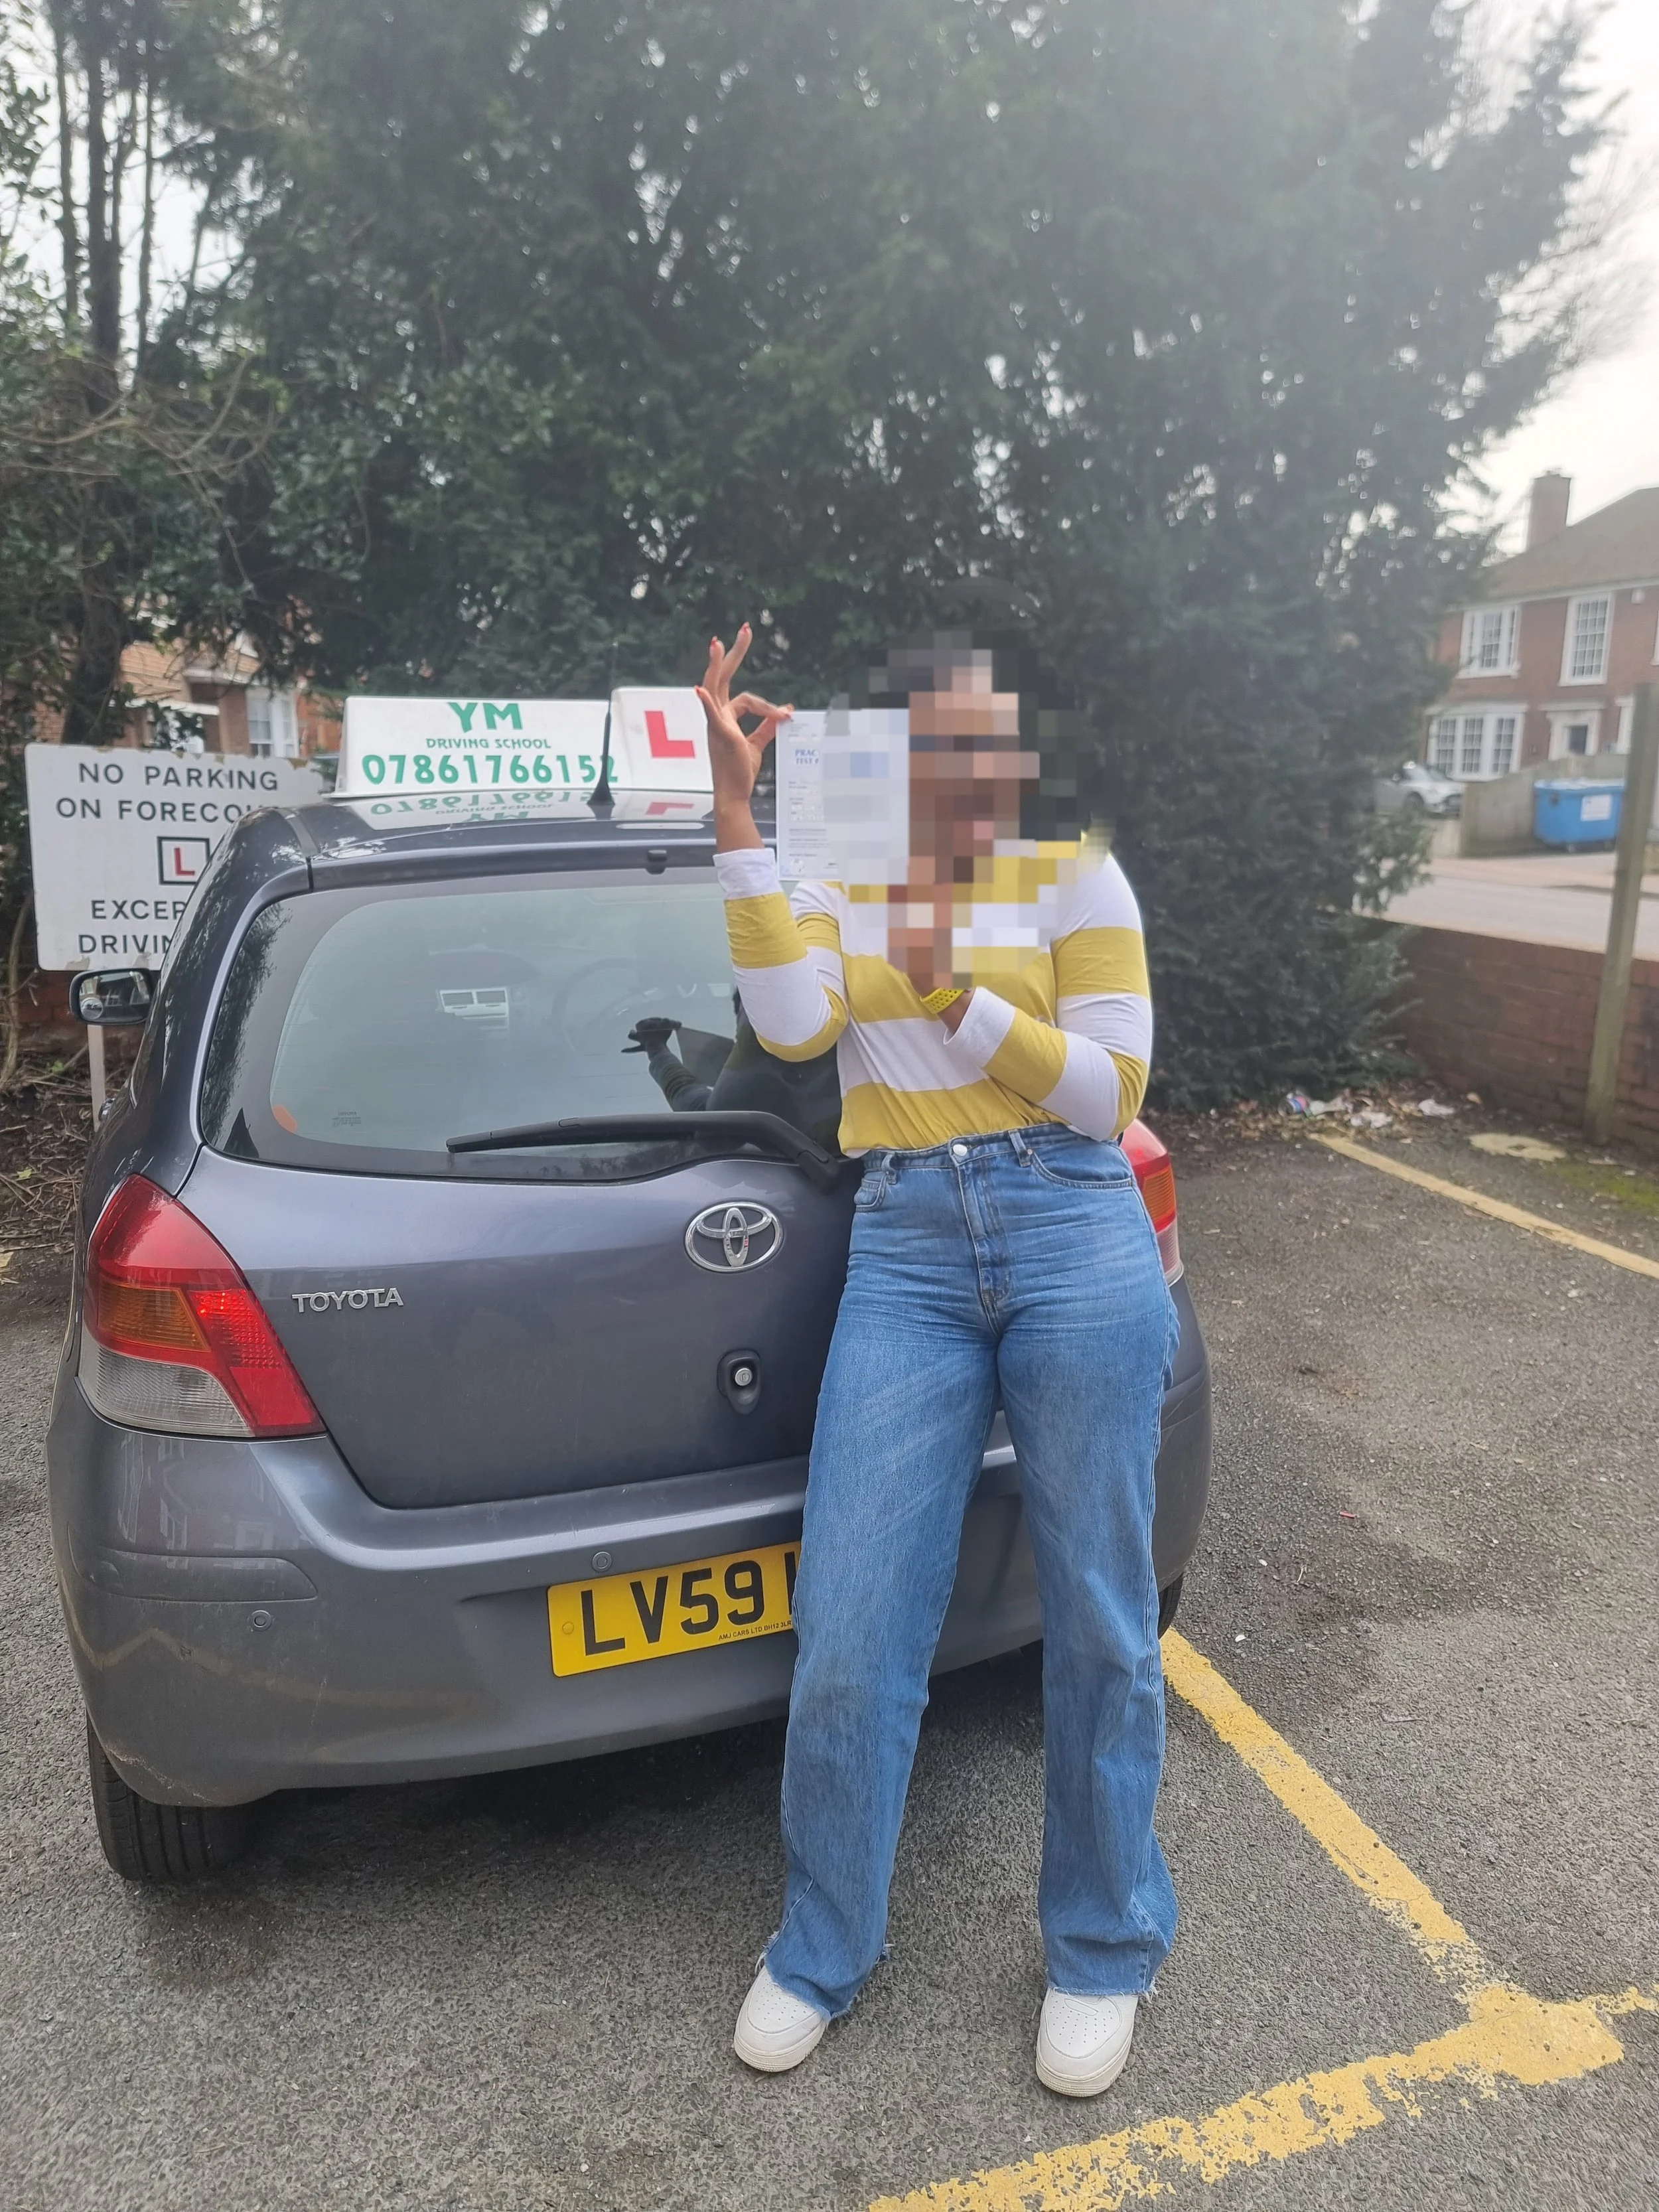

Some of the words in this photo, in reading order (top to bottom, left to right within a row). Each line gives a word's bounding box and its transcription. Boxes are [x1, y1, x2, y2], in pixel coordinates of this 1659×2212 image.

[449, 702, 523, 733] YM
[425, 738, 489, 749] DRIVING
[495, 739, 551, 749] SCHOOL
[644, 710, 696, 759] L
[79, 763, 124, 784] NO
[145, 766, 278, 791] PARKING
[362, 754, 618, 784] 07861766152
[56, 797, 101, 819] ON
[174, 848, 195, 876] L
[292, 1288, 403, 1313] TOYOTA
[580, 1560, 765, 1656] LV59
[733, 1629, 750, 1638] CARS
